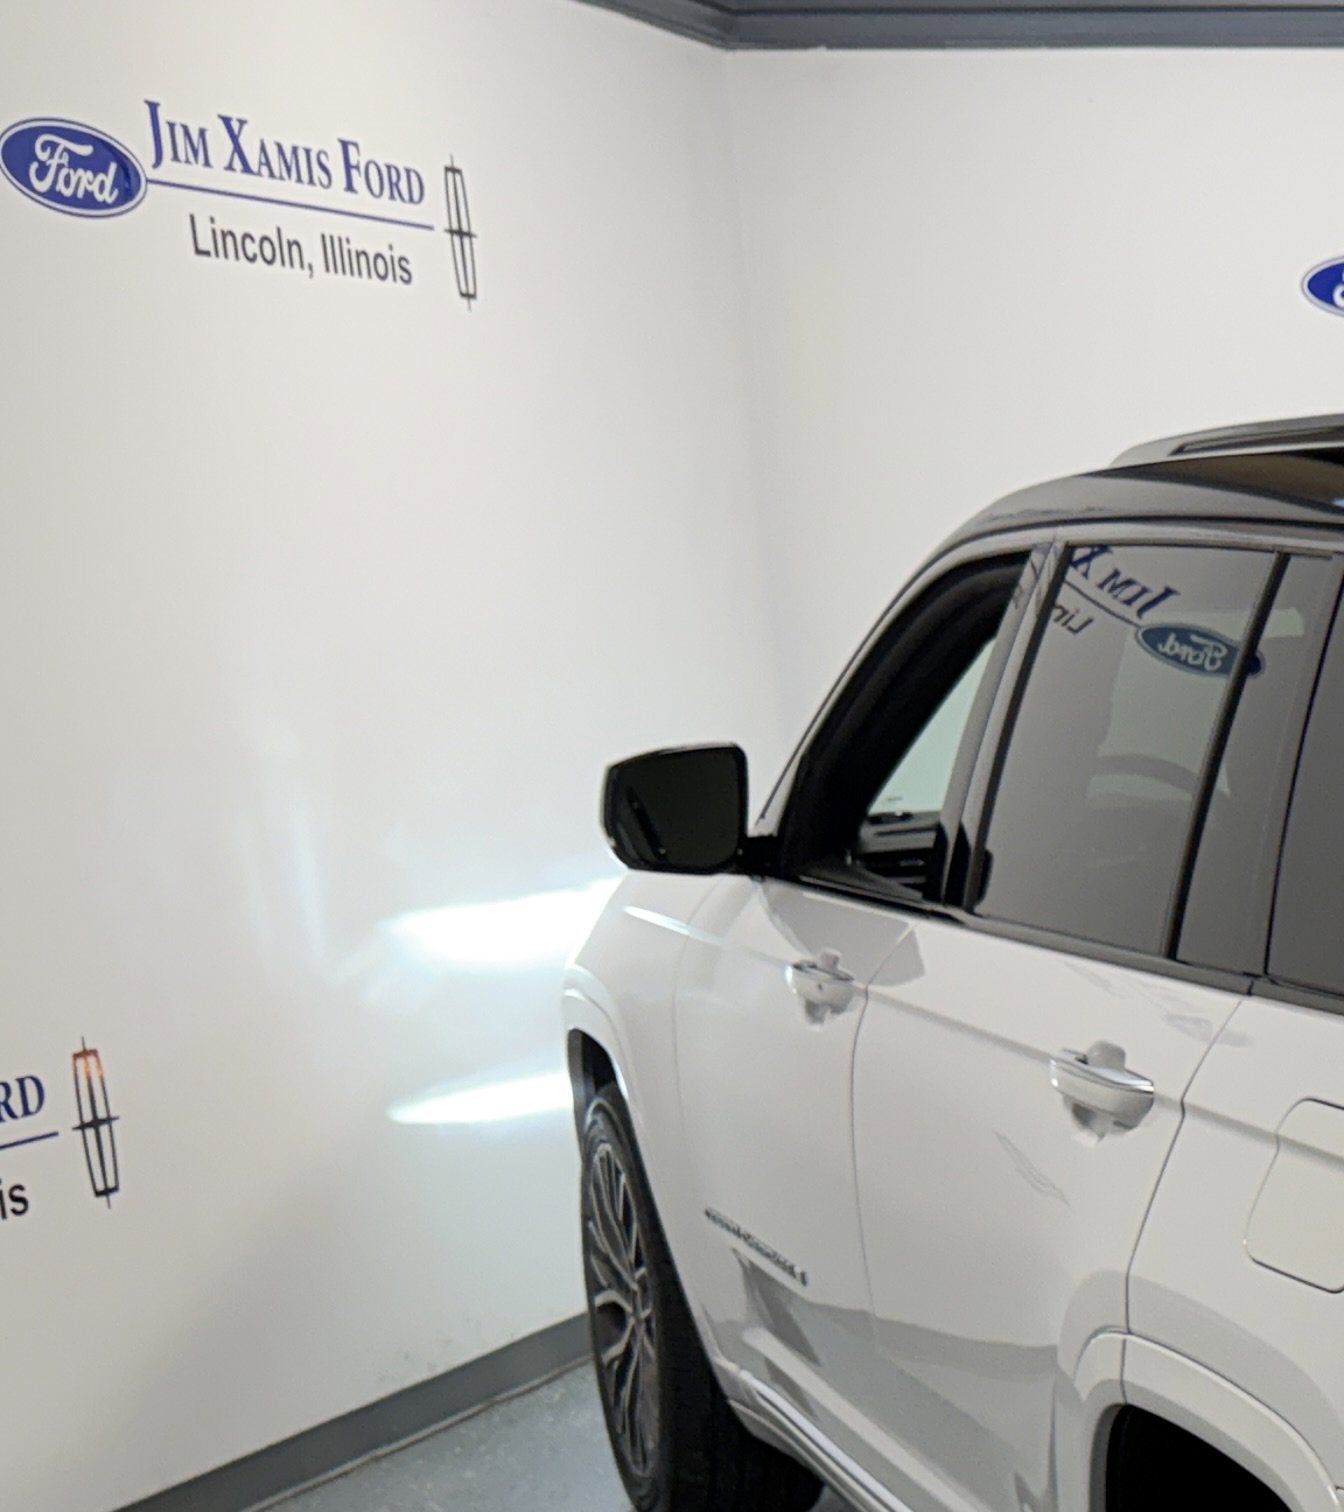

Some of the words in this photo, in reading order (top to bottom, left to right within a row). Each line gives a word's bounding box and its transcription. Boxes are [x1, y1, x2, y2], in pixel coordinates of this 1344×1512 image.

[29, 133, 120, 204] Ford
[144, 99, 215, 170] JIM
[217, 114, 334, 190] XAMIS
[337, 138, 426, 205] FORD
[188, 213, 316, 279] Lincoln,
[320, 232, 414, 286] Illinois
